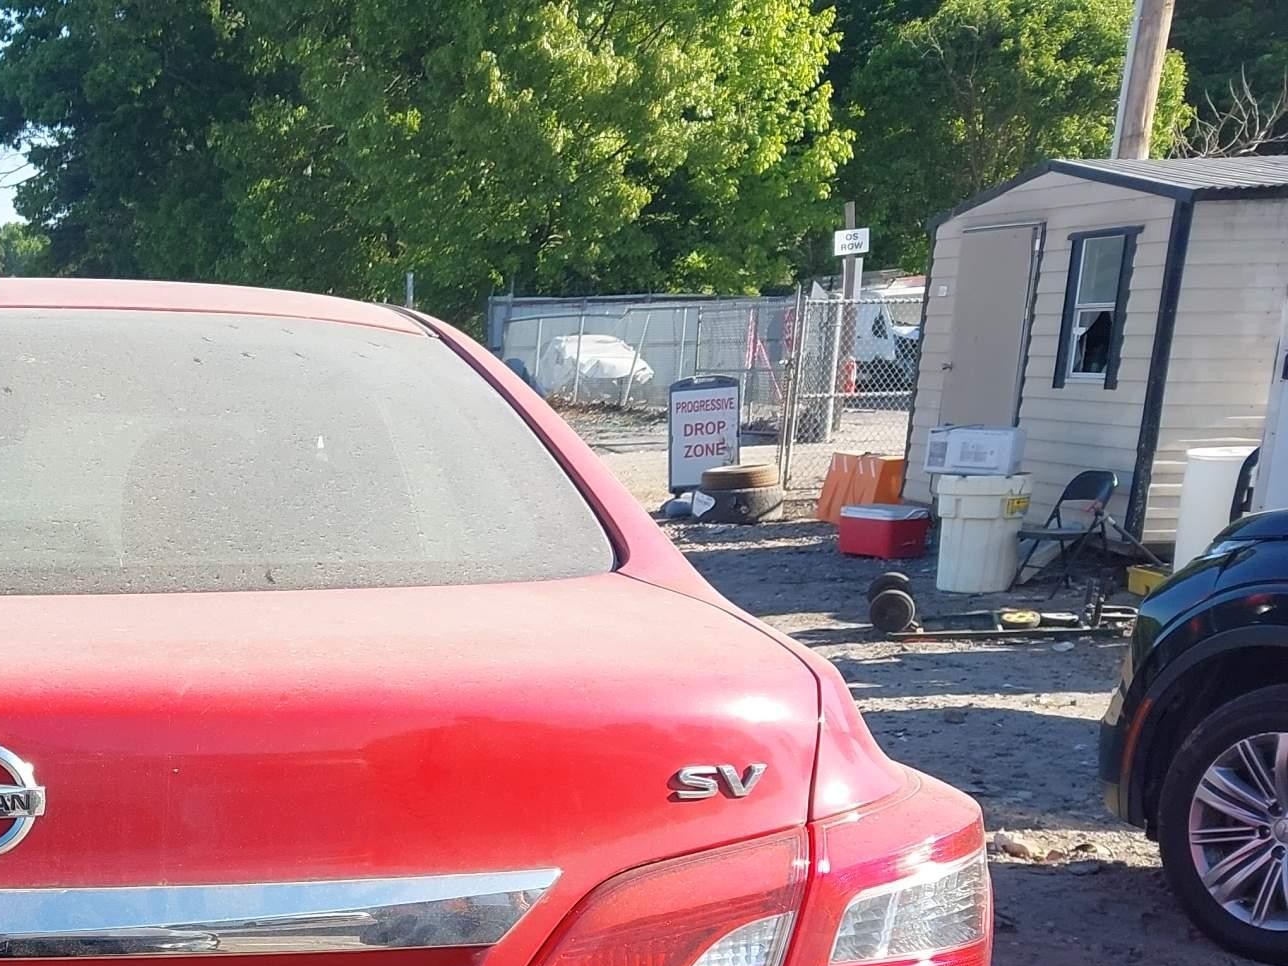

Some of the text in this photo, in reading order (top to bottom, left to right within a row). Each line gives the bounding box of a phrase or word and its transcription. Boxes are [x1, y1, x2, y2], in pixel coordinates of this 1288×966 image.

[840, 241, 864, 251] ROW
[675, 397, 735, 414] PROGRESSIVE
[683, 420, 727, 437] DROP
[683, 442, 726, 458] ZONE
[674, 763, 768, 801] SV
